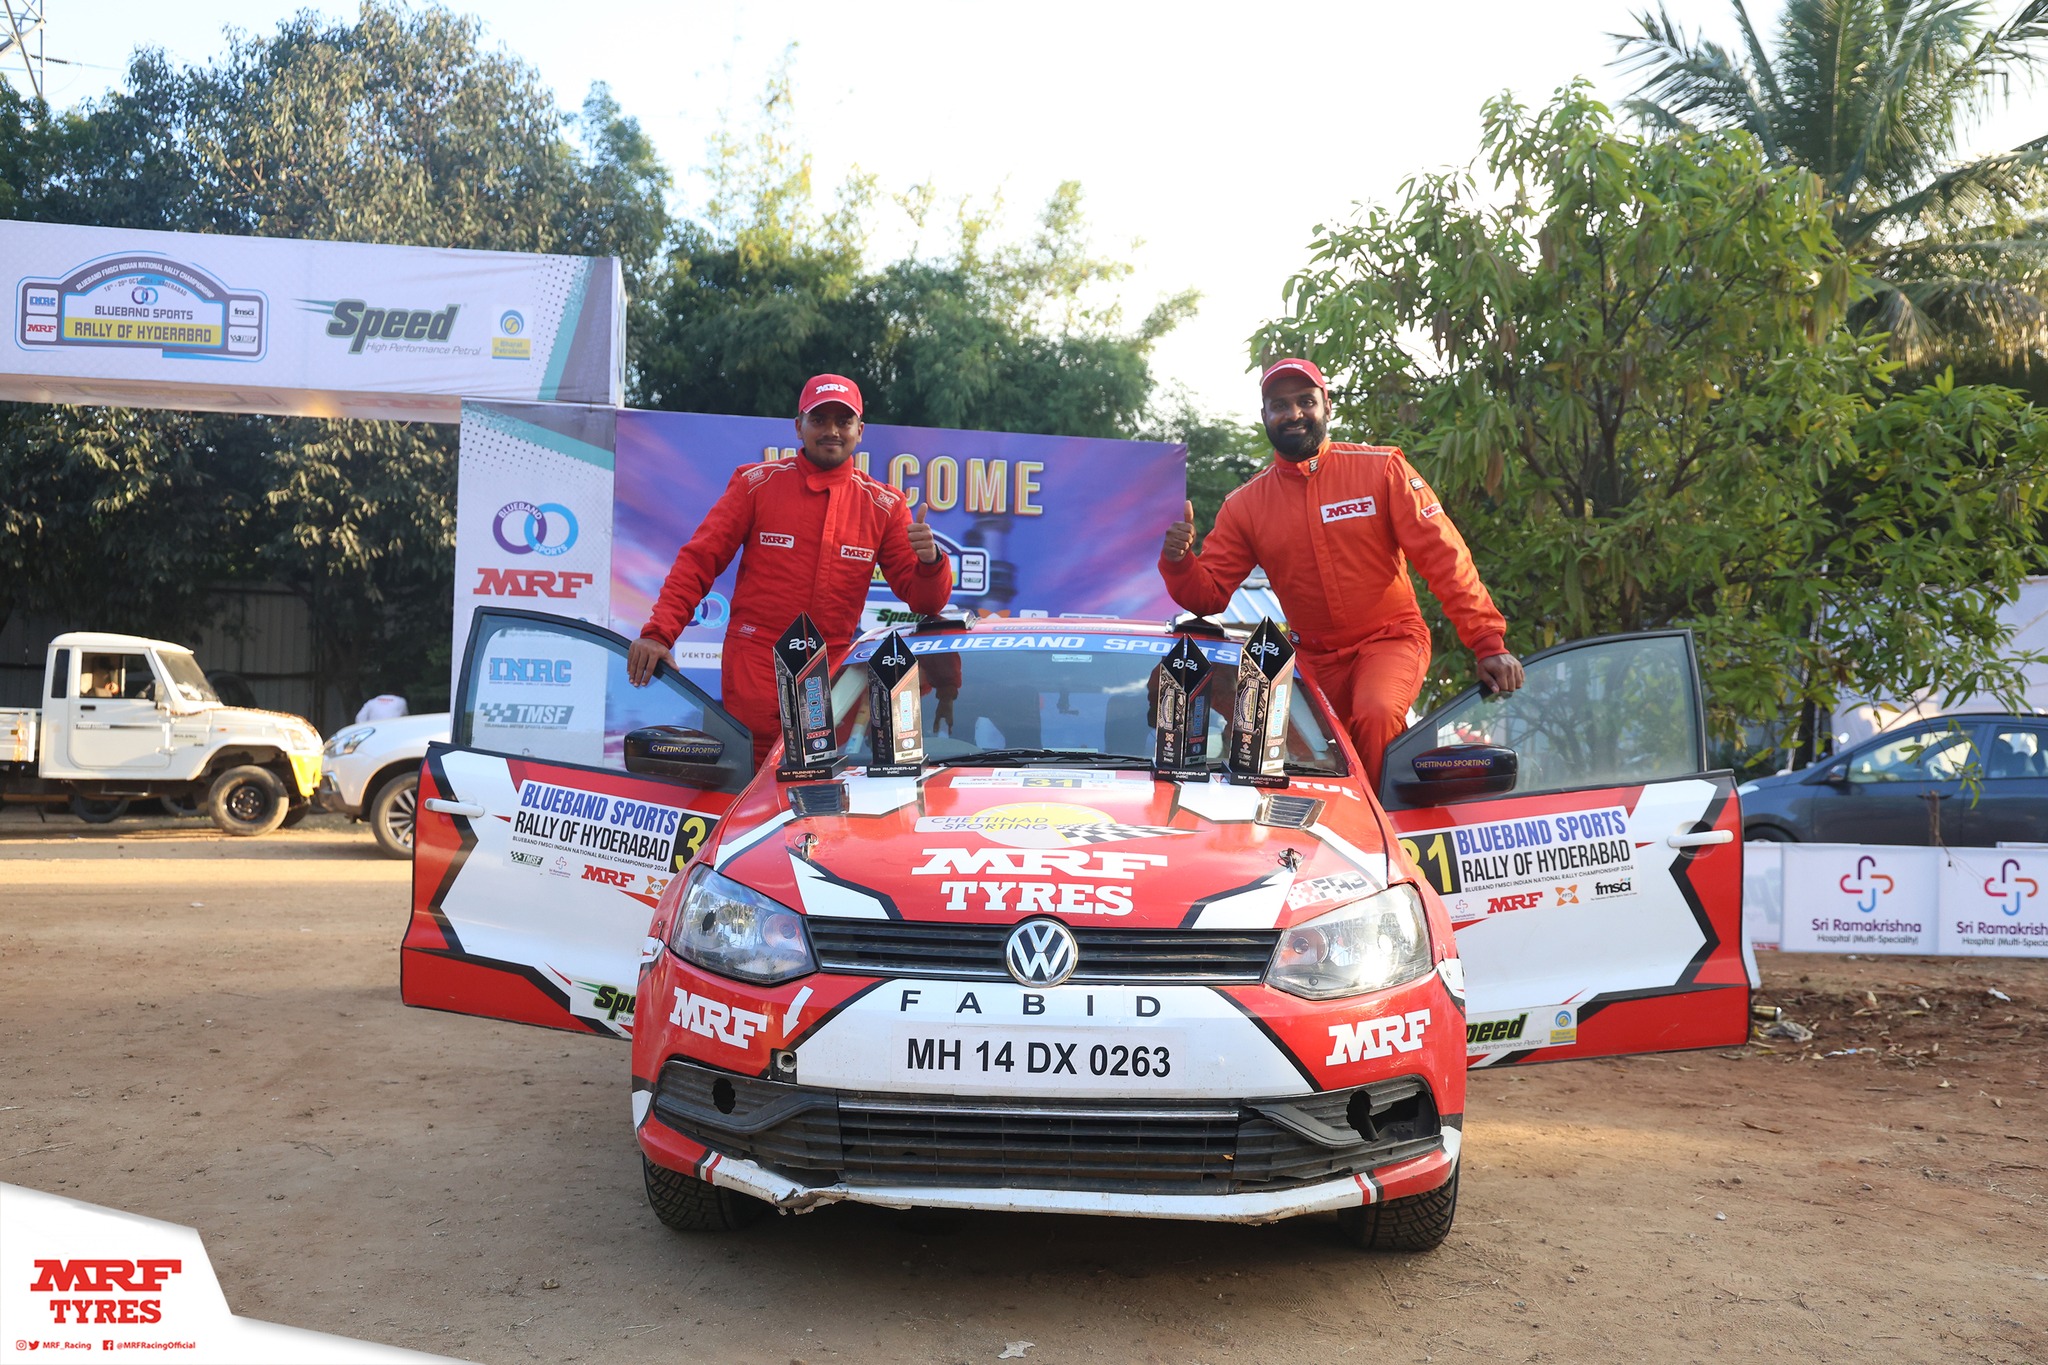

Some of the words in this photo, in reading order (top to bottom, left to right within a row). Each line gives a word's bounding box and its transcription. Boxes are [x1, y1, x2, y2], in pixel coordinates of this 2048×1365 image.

[76, 271, 102, 291] BLUEBAND
[101, 265, 119, 277] FMSCI
[119, 261, 137, 271] INDIAN
[138, 261, 163, 271] NATIONAL
[164, 265, 181, 277] RALLY
[179, 271, 214, 298] CHAMPIONSHIP
[94, 305, 149, 318] BLUEBAND
[153, 308, 193, 320] SPORTS
[26, 323, 56, 333] MRF
[74, 321, 112, 339] RALLY
[117, 324, 132, 339] OF
[137, 325, 212, 343] HYDERABAD
[326, 299, 461, 355] Speed
[366, 342, 387, 354] High
[389, 343, 450, 354] Performance
[452, 346, 482, 356] Petrol
[815, 383, 849, 395] MRF
[497, 502, 543, 521] BLUEBAND
[1326, 500, 1373, 518] MRF
[533, 542, 568, 556] SPORTS
[761, 534, 792, 546] MRF
[842, 547, 873, 559] MRF
[473, 567, 593, 599] MRF
[789, 637, 817, 650] 2024
[909, 636, 1086, 652] BLUEBAND
[1103, 638, 1238, 663] SPOTS
[1250, 641, 1280, 656] 2024
[882, 654, 907, 666] 2024
[1173, 658, 1198, 671] 2024
[489, 657, 572, 683] INRC
[516, 705, 568, 724] TMSF
[651, 744, 691, 753] CHETTINAD
[1415, 759, 1453, 769] CHETTINAD
[1027, 778, 1073, 788] 31
[521, 783, 609, 822] BLUEBAND
[610, 800, 678, 836] SPORTS
[931, 817, 1048, 825] CHETTINAD
[942, 823, 1048, 831] SPORTING
[514, 810, 560, 839] RALLY
[559, 819, 580, 842] OF
[579, 823, 670, 862] HYDERABAD
[1456, 819, 1551, 856] BLUEBAND
[1555, 810, 1626, 841] SPORTS
[675, 816, 706, 872] 3
[512, 836, 538, 846] BLUEBAND
[538, 840, 554, 849] FMSCI
[554, 844, 572, 852] INDIAN
[572, 847, 597, 858] NATIONAL
[597, 853, 613, 861] RALLY
[613, 857, 654, 869] CHAMPIONSHIP
[654, 864, 667, 872] 2024
[1462, 854, 1508, 883] RALLY
[1514, 851, 1533, 876] OF
[1534, 839, 1631, 874] HYDERABAD
[911, 848, 1168, 880] MRF
[581, 864, 635, 888] MRF
[1465, 884, 1494, 893] BLUEBAND
[1495, 881, 1512, 889] FMSCI
[1513, 878, 1533, 886] INDIAN
[1533, 874, 1561, 883] NATIONAL
[1561, 872, 1578, 880] RALLY
[1579, 867, 1620, 877] CHAMPIONSHIP
[1595, 877, 1631, 895] fmsci
[940, 881, 1134, 916] TYRES
[1487, 891, 1543, 914] MRF
[1812, 919, 1829, 931] Sri
[1833, 918, 1922, 933] Ramakrishna
[1957, 922, 1973, 934] Sri
[1817, 934, 1850, 944] Hospital
[1852, 935, 1919, 946] (Multi-Speciality)
[1962, 937, 1995, 947] Hospital
[593, 984, 637, 1021] Spe
[669, 986, 768, 1050] MRF
[1325, 1008, 1431, 1067] MRF
[1466, 1012, 1529, 1045] peed
[1481, 1042, 1522, 1051] Performance
[907, 1038, 961, 1071] MH
[976, 1041, 1014, 1072] 14
[1028, 1042, 1078, 1075] DX
[1090, 1045, 1171, 1078] 0263
